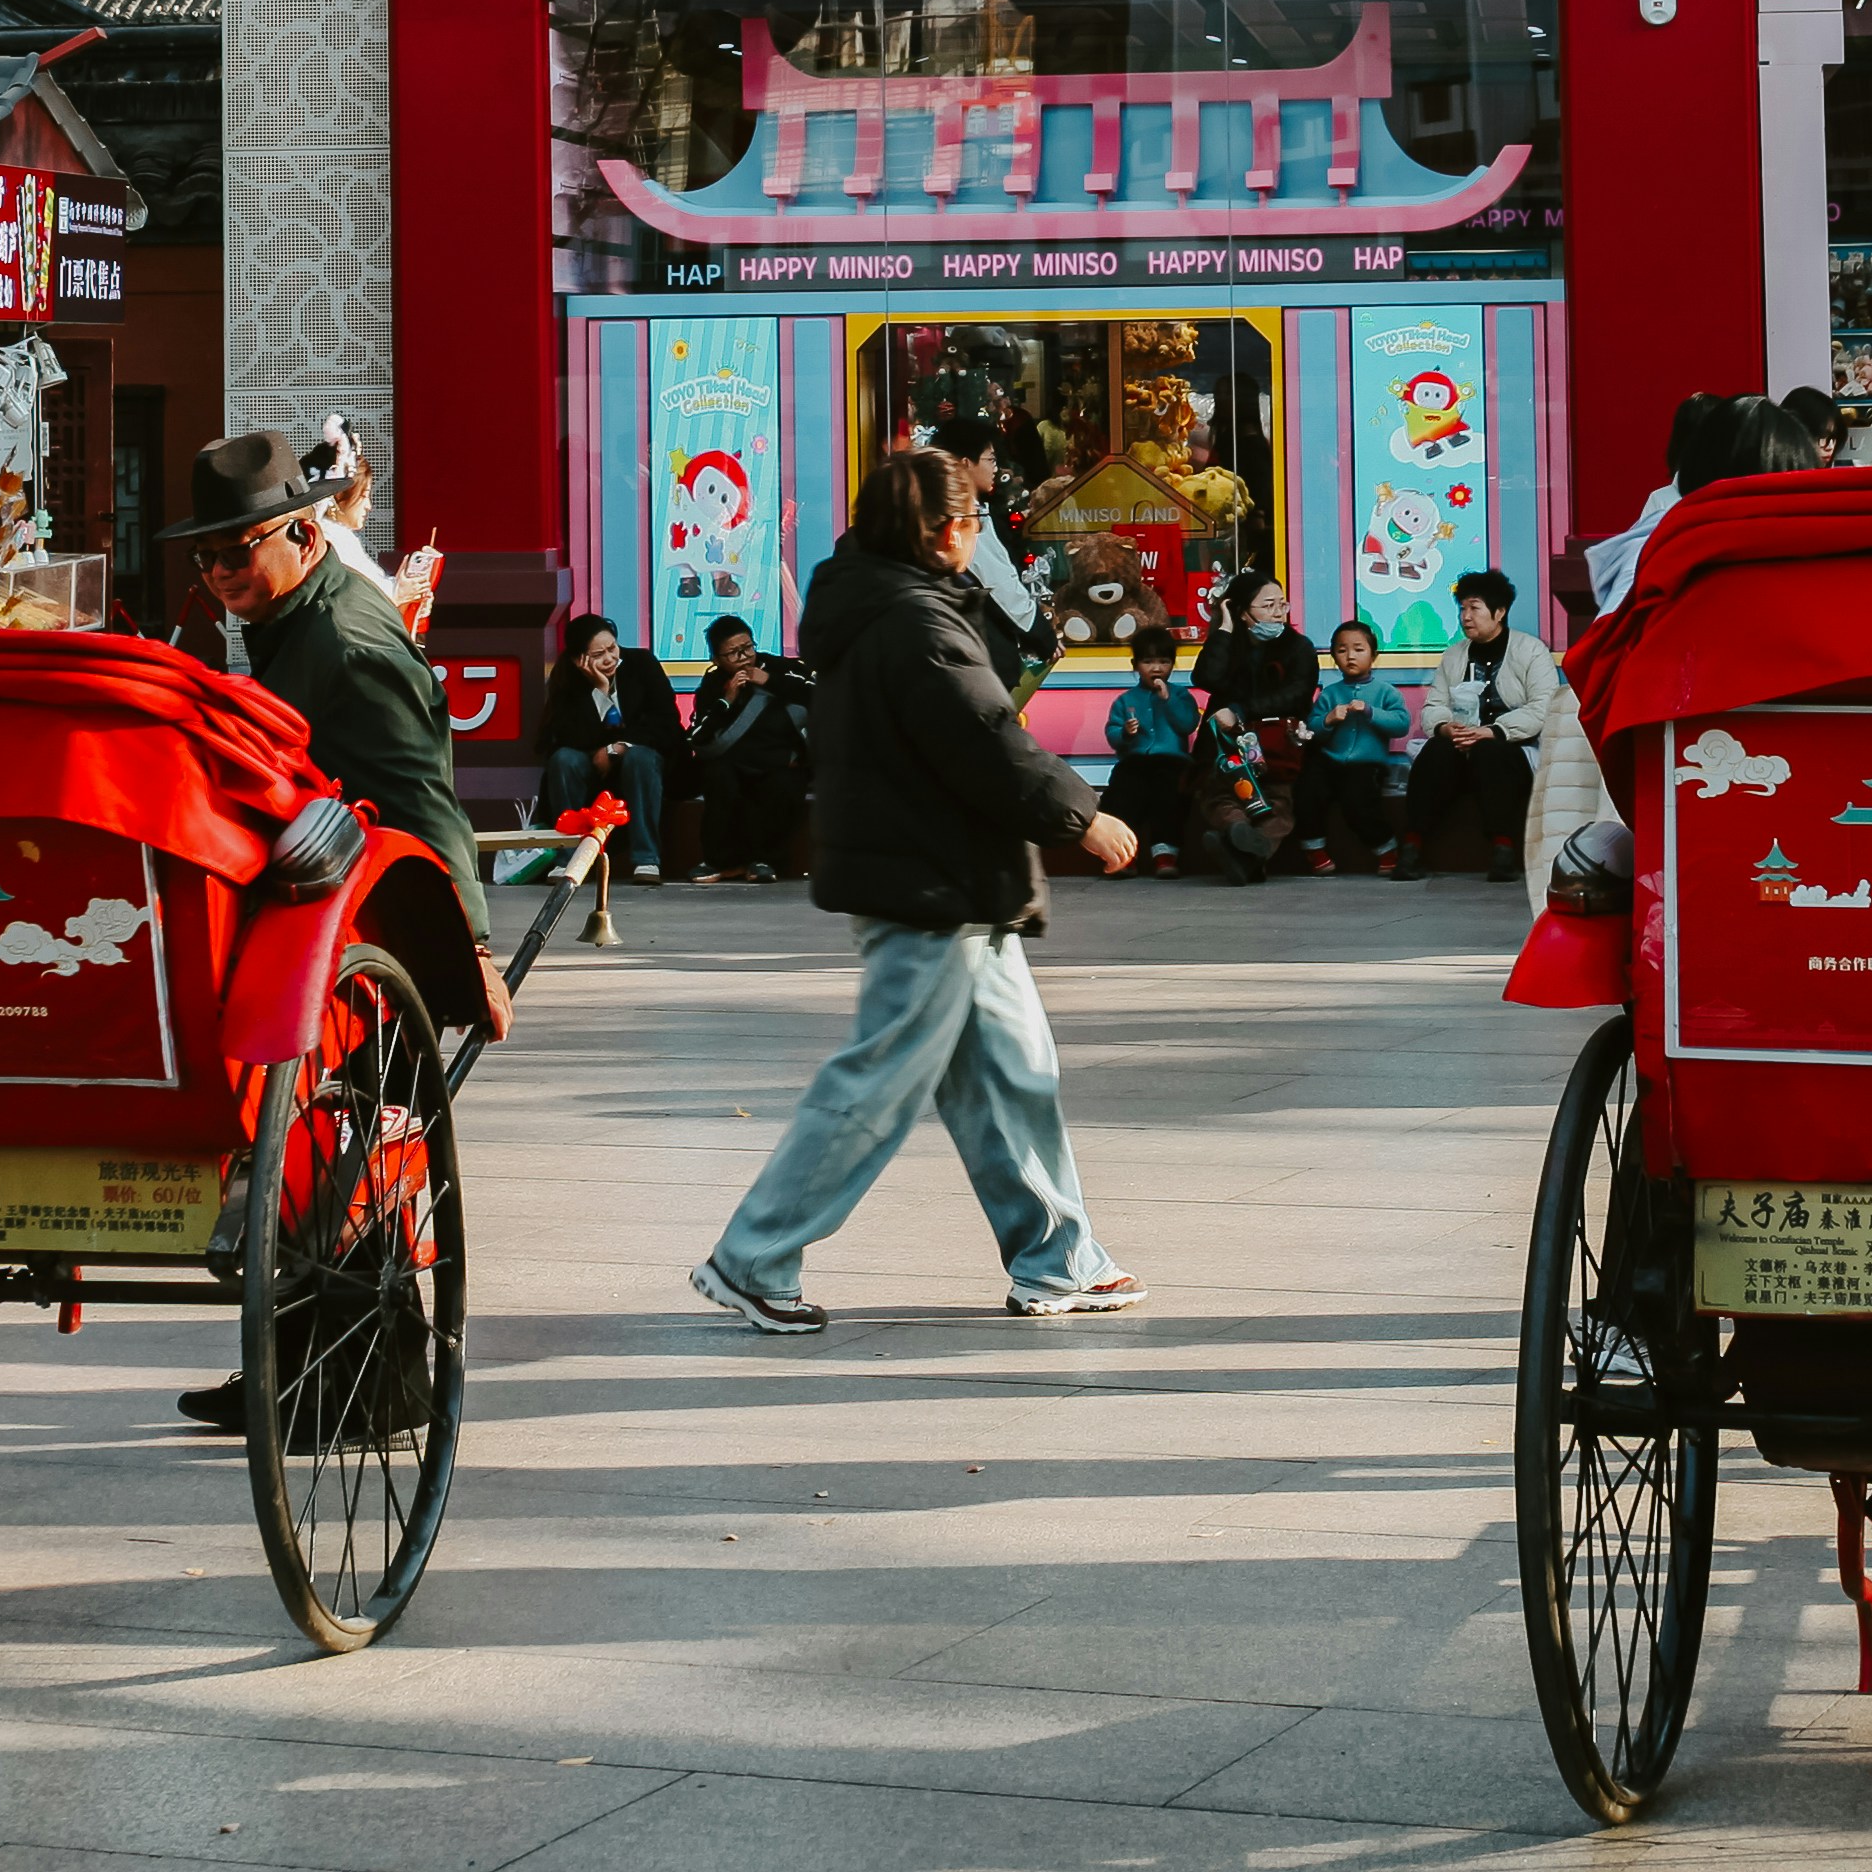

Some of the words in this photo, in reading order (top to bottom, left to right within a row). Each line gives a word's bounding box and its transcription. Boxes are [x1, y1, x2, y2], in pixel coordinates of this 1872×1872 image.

[1465, 208, 1531, 230] APPY
[667, 264, 722, 286] HAP
[740, 257, 818, 281] HAPPY
[828, 254, 914, 280] MINISO
[942, 253, 1022, 278] HAPPY
[1032, 251, 1119, 277] MINISO
[1147, 249, 1227, 275] HAPPY
[1237, 247, 1324, 274] MINISO
[1353, 245, 1403, 272] HAP
[59, 255, 121, 301] 门票代售点
[1058, 508, 1122, 524] MINISO
[1129, 506, 1181, 523] LAND
[97, 1160, 203, 1182] 旅游观光车
[1716, 1190, 1811, 1232] 夫子庙
[1719, 1232, 1757, 1244] Welcome
[1759, 1235, 1768, 1244] to
[1814, 1237, 1846, 1248] Temple
